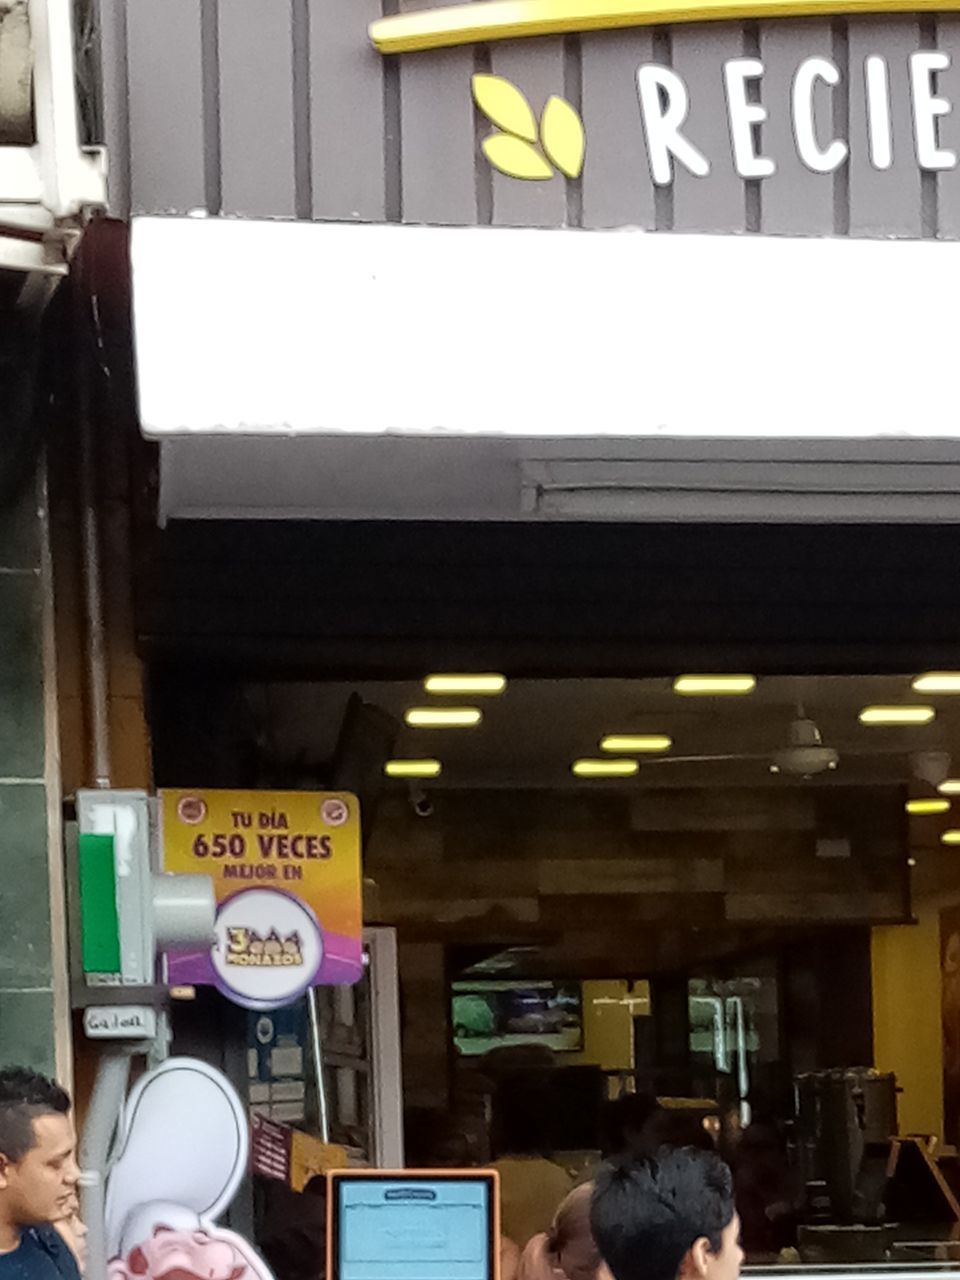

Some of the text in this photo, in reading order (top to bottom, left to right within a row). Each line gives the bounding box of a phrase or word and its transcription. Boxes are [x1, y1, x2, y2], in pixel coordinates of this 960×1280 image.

[231, 807, 289, 829] TU DÍA
[193, 834, 332, 859] 650 VECES
[223, 864, 303, 880] MEJOR EN
